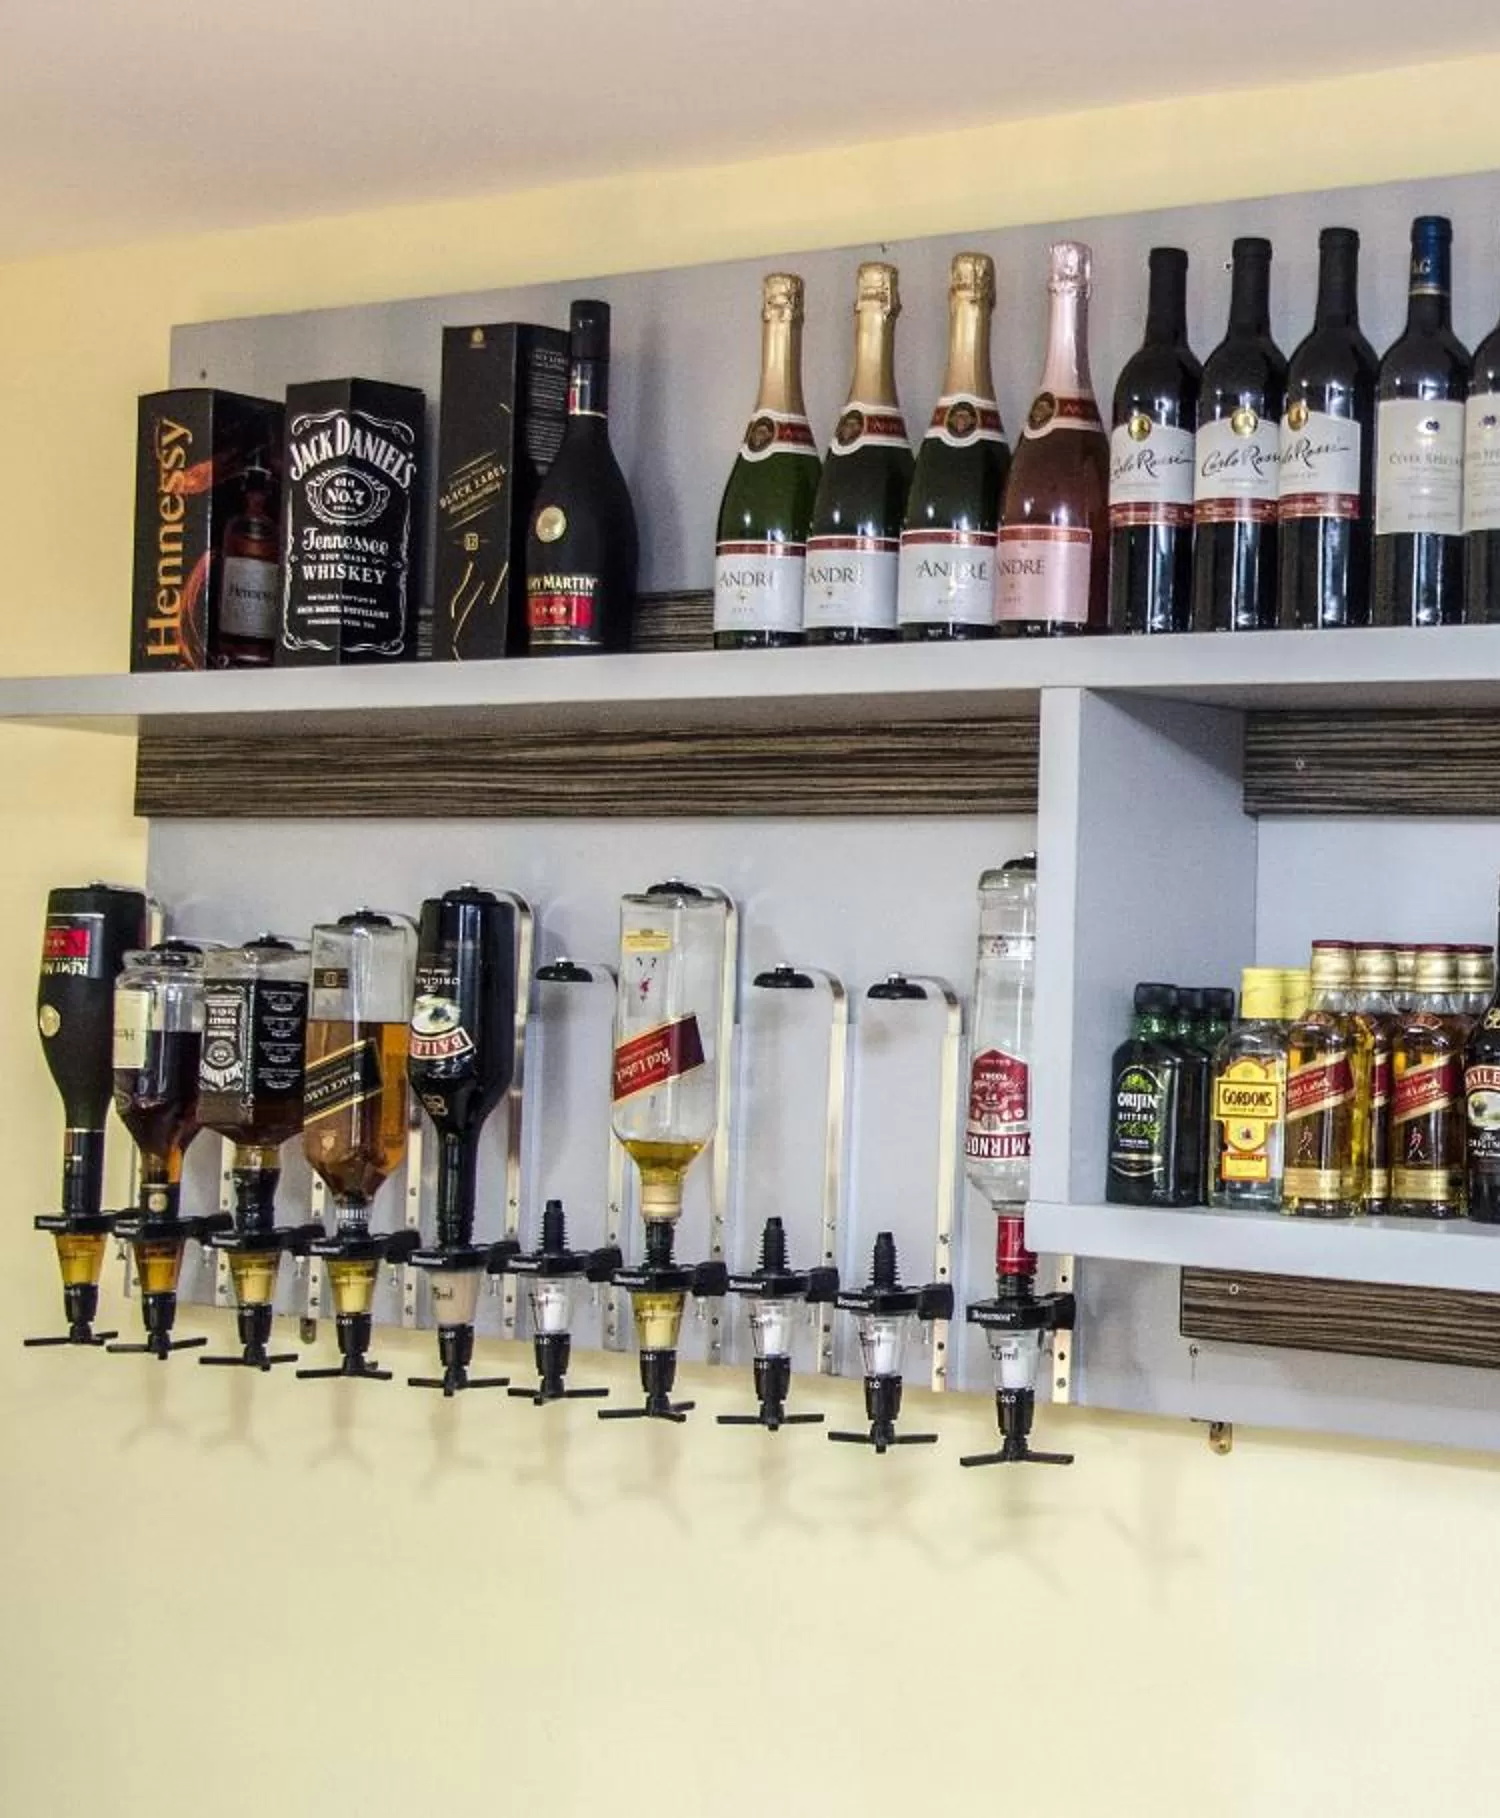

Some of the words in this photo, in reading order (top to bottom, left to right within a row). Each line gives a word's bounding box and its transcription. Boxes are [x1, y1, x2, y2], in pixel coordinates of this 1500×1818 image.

[290, 429, 335, 481] JACK
[336, 417, 417, 489] DANIEL'S
[146, 418, 193, 657] Hennessy
[302, 526, 390, 556] Tennessee
[302, 563, 387, 585] WHISKEY
[808, 564, 864, 585] ANDR
[412, 1031, 465, 1056] BAILE
[647, 1047, 672, 1069] Red
[330, 1071, 361, 1092] BLACK
[1118, 1092, 1158, 1112] ORIJIN
